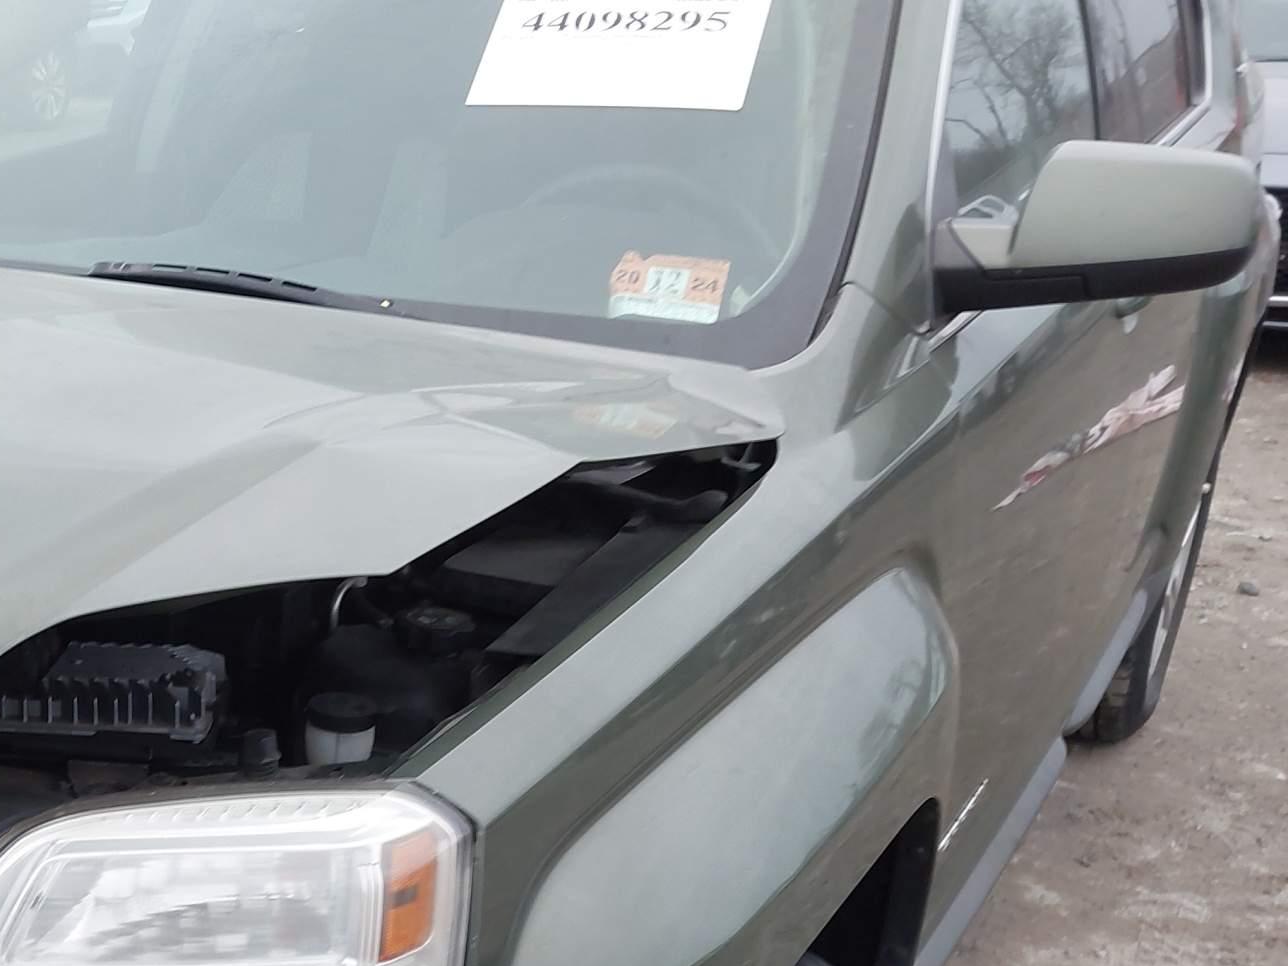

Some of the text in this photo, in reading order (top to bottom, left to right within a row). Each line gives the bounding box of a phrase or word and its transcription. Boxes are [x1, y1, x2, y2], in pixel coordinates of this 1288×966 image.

[521, 10, 731, 32] 44098295
[615, 269, 642, 286] 20
[691, 277, 720, 294] 24
